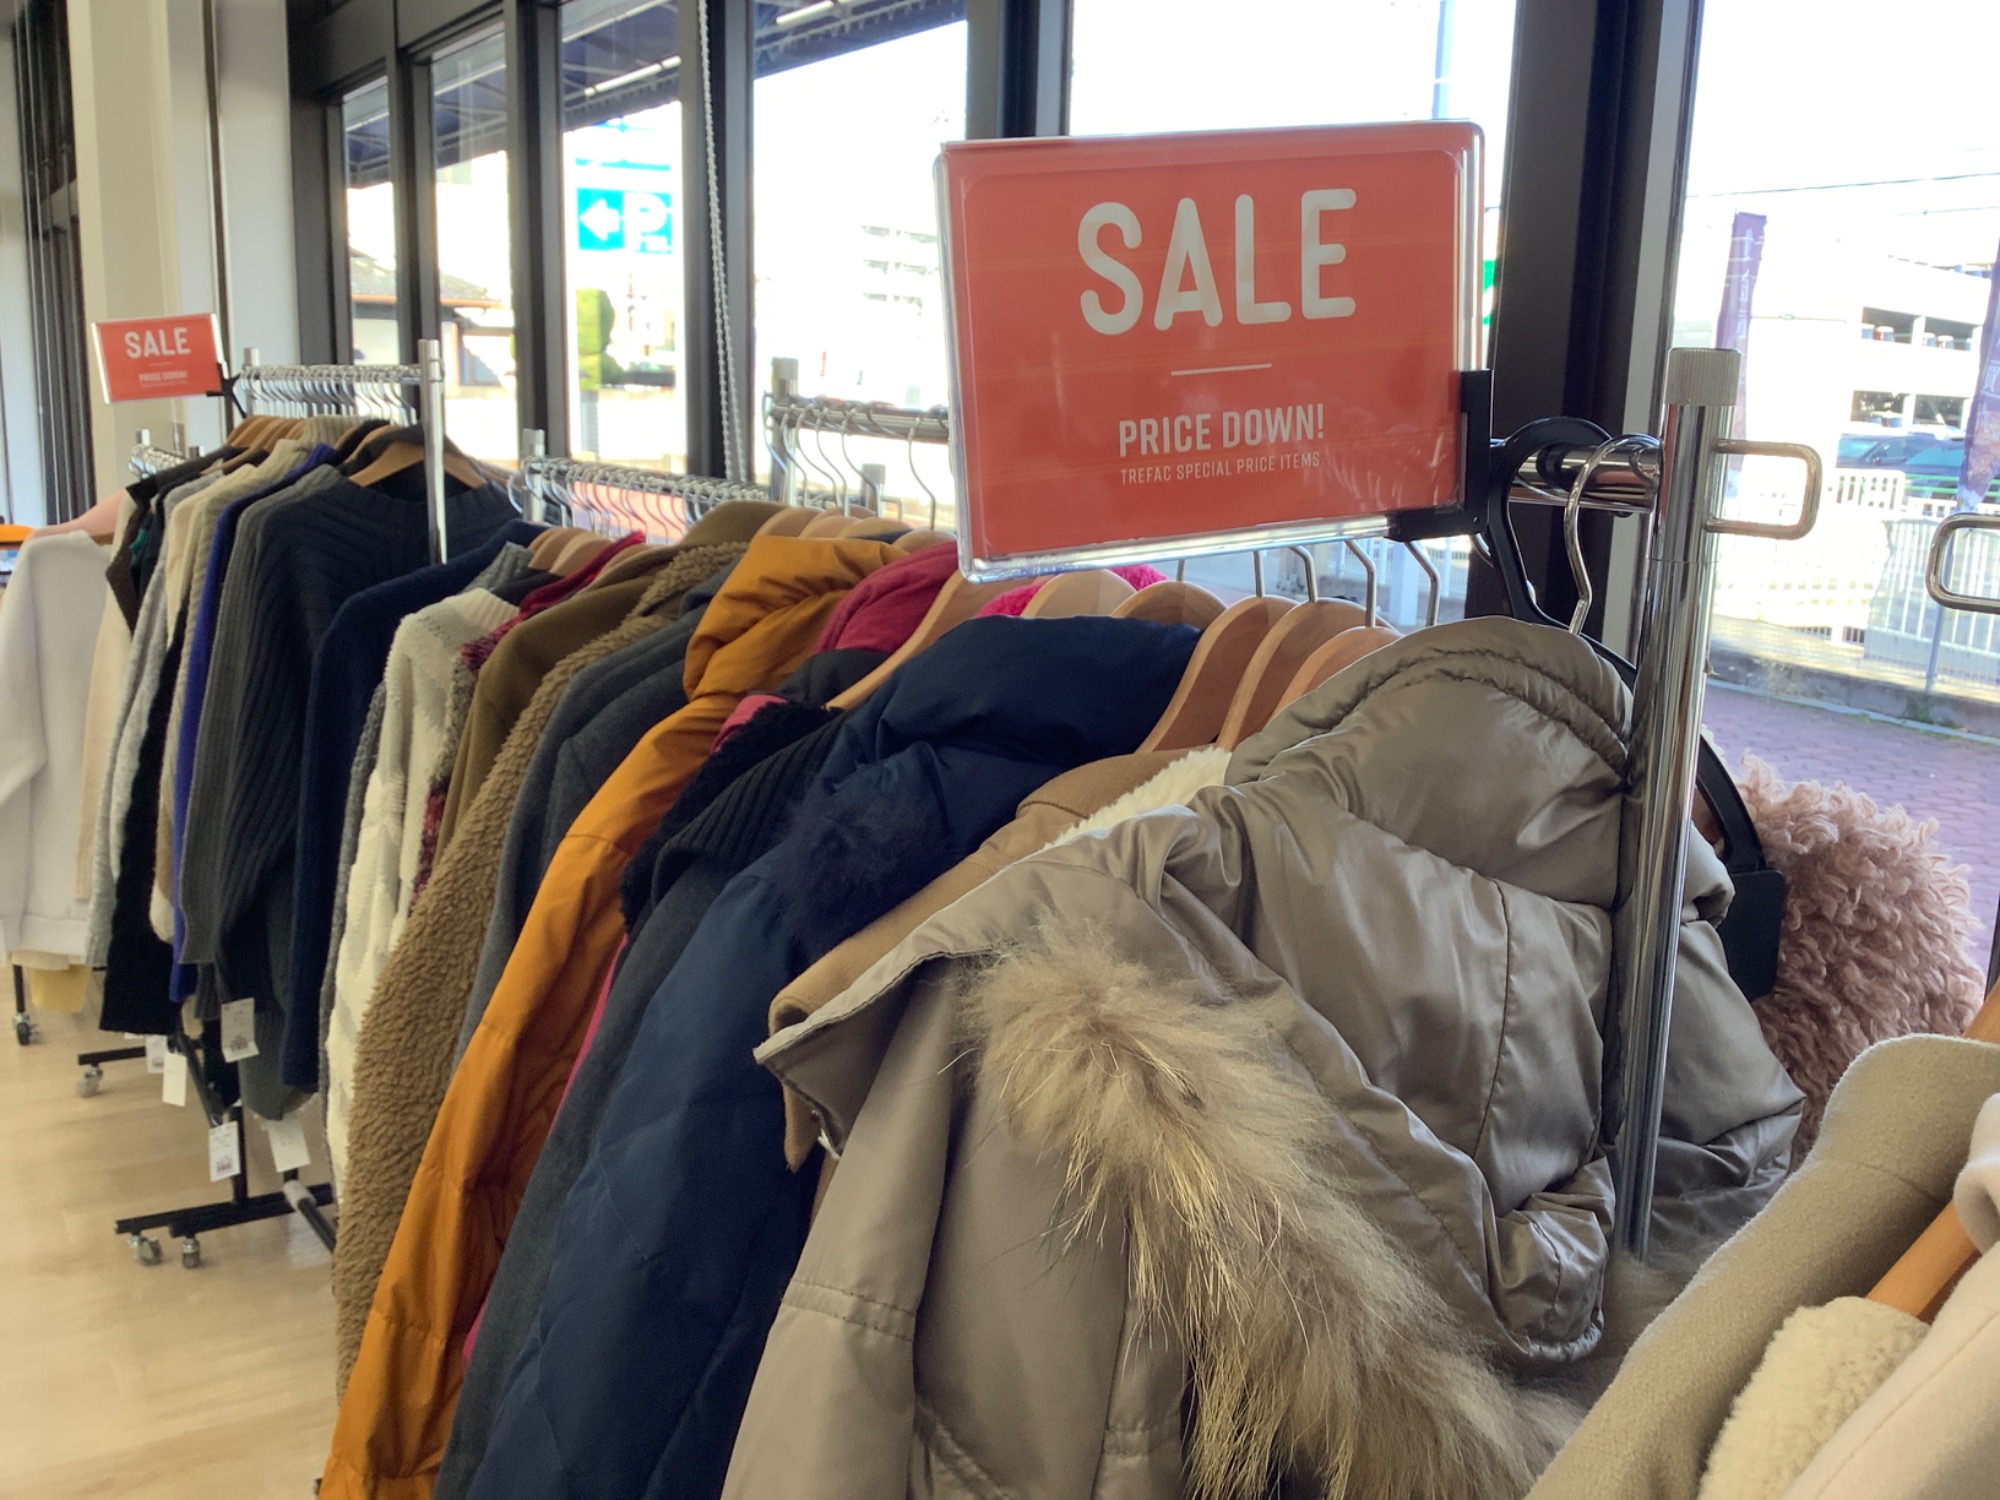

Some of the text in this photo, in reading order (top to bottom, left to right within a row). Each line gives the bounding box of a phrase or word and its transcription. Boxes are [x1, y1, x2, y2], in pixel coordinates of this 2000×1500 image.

[623, 192, 668, 251] P
[1078, 188, 1356, 335] SALE
[124, 327, 190, 359] SALE
[1119, 403, 1324, 457] PRICE DOWN!
[1120, 464, 1172, 485] TREFAC
[1176, 459, 1231, 480] SPECIAL
[1236, 455, 1275, 475] PRICE
